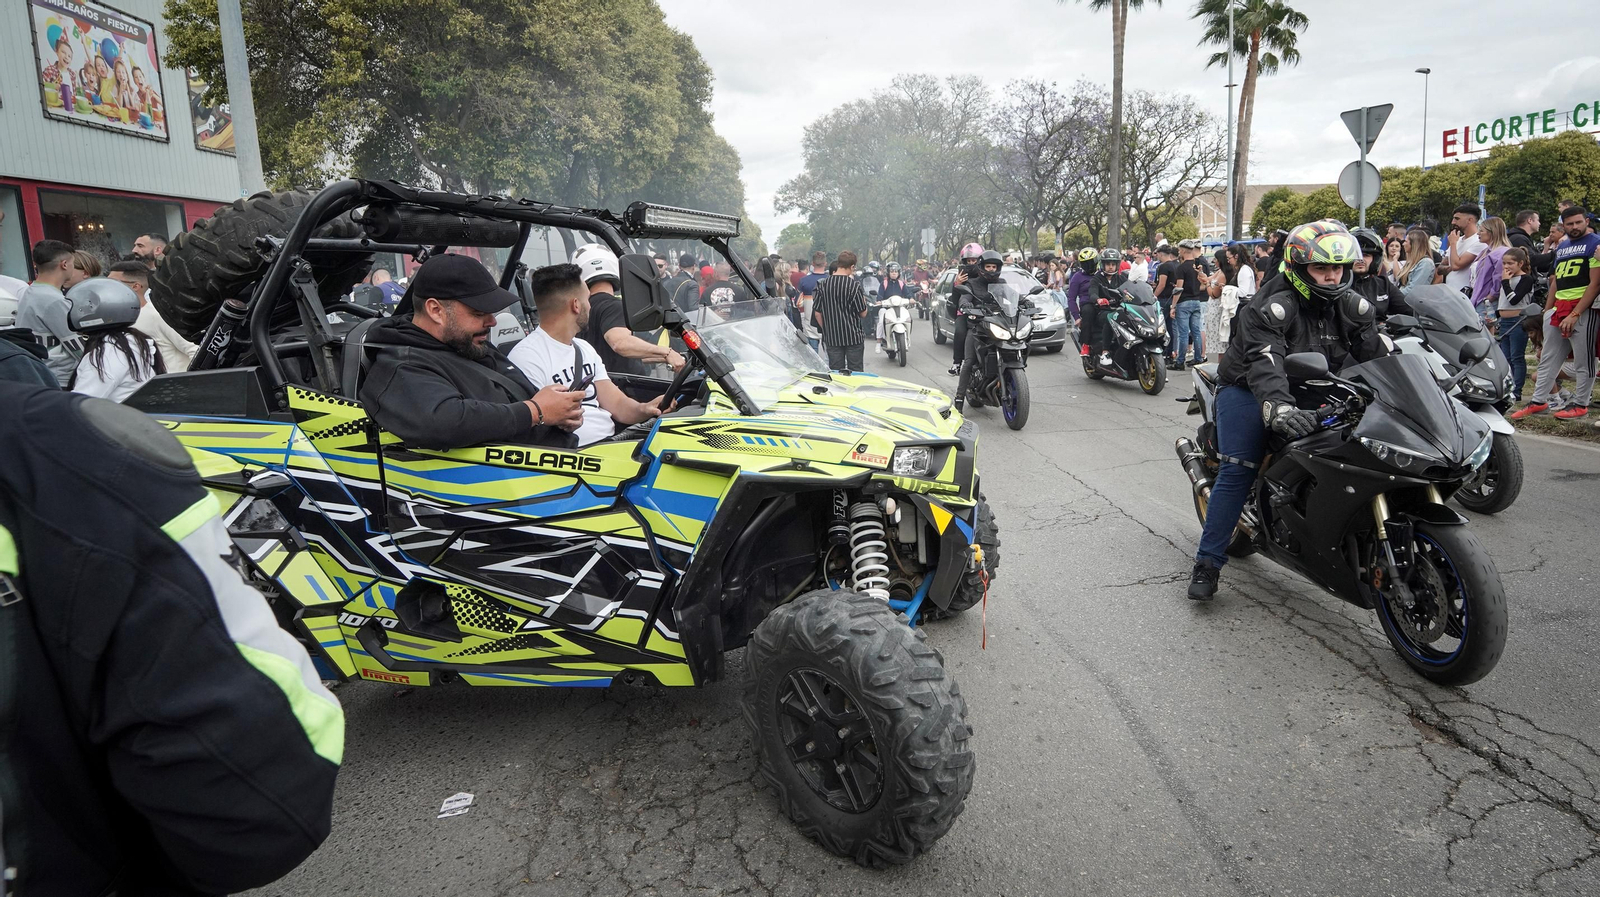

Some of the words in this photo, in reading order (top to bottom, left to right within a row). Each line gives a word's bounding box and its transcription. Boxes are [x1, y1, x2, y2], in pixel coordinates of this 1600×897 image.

[44, 0, 99, 21] MPLEAÑOS
[107, 17, 139, 36] FIESTAS
[1475, 109, 1556, 145] CORTE
[1561, 244, 1587, 256] YAMAHA
[1555, 258, 1584, 279] 46
[206, 326, 231, 356] FOX
[497, 326, 519, 337] RZR
[485, 448, 602, 473] POLARIS
[852, 451, 888, 465] PIRELLI
[362, 667, 410, 684] PIRELLI
